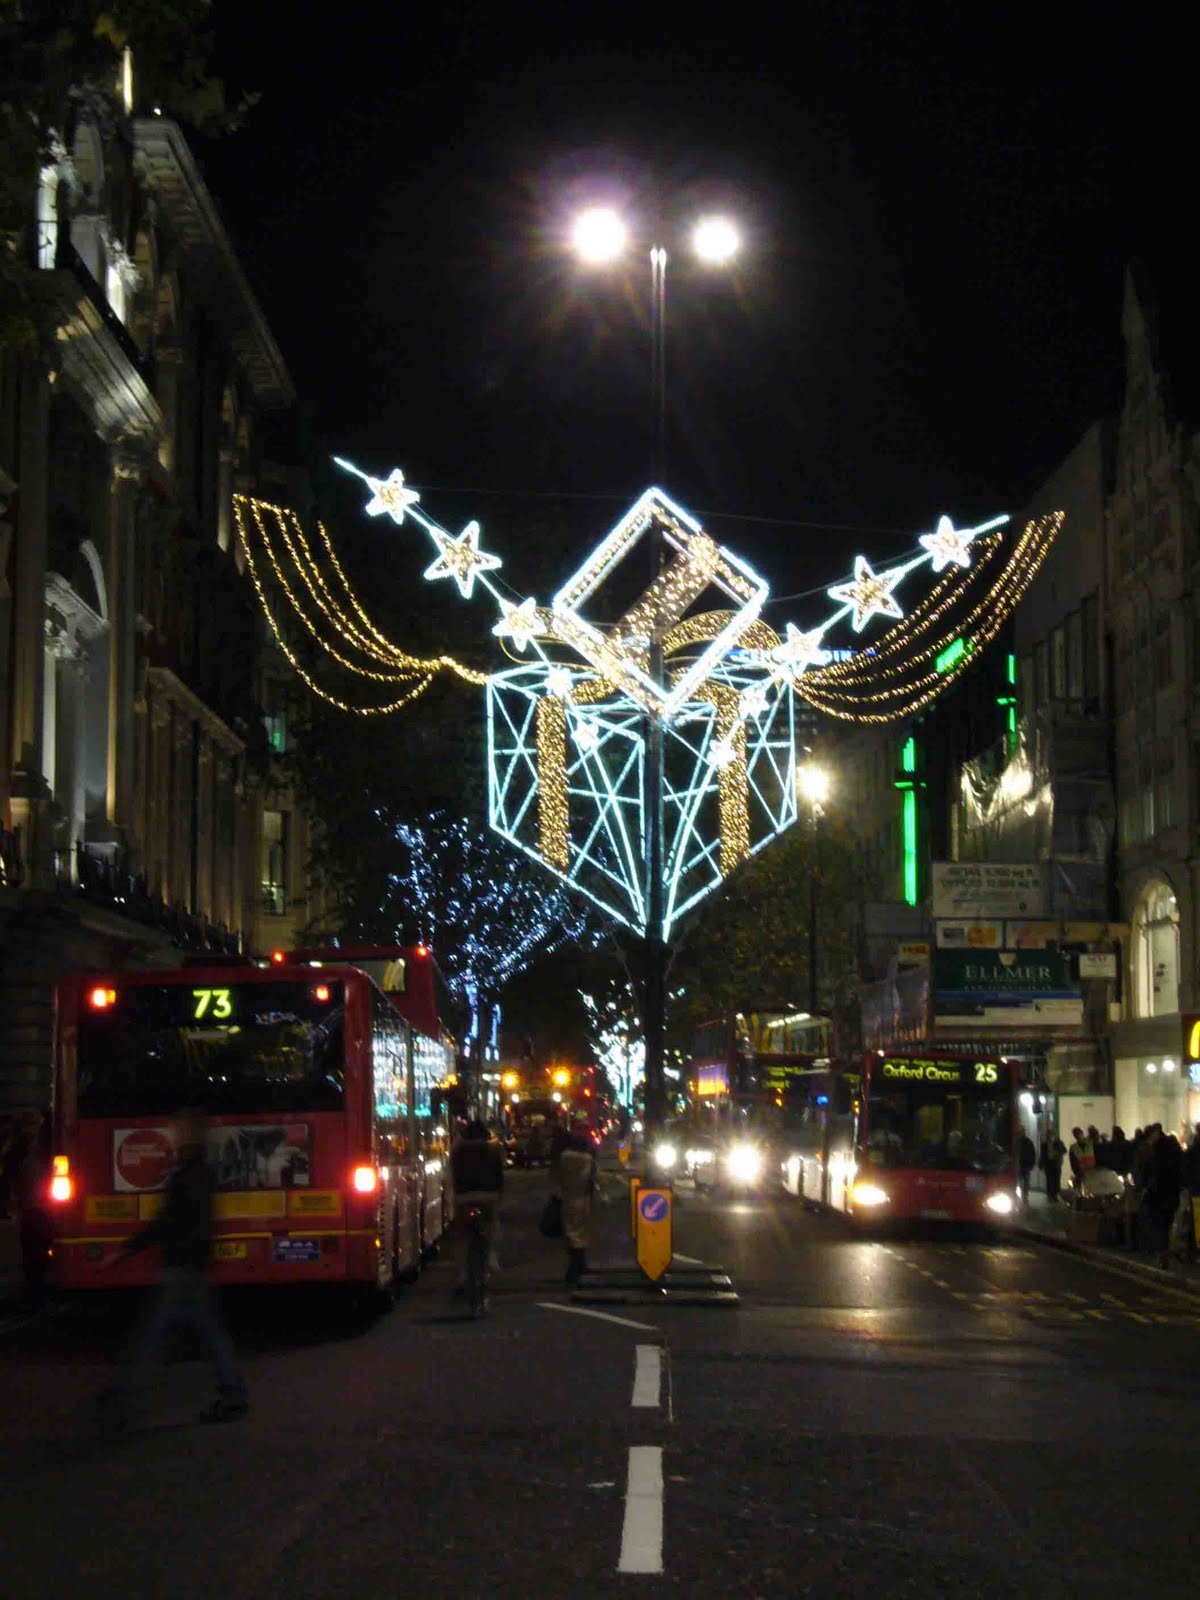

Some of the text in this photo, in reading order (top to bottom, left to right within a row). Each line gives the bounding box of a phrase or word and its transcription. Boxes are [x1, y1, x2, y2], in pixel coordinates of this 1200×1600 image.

[192, 988, 232, 1019] 73
[882, 1063, 961, 1081] Oxford Circus
[974, 1062, 999, 1083] 25
